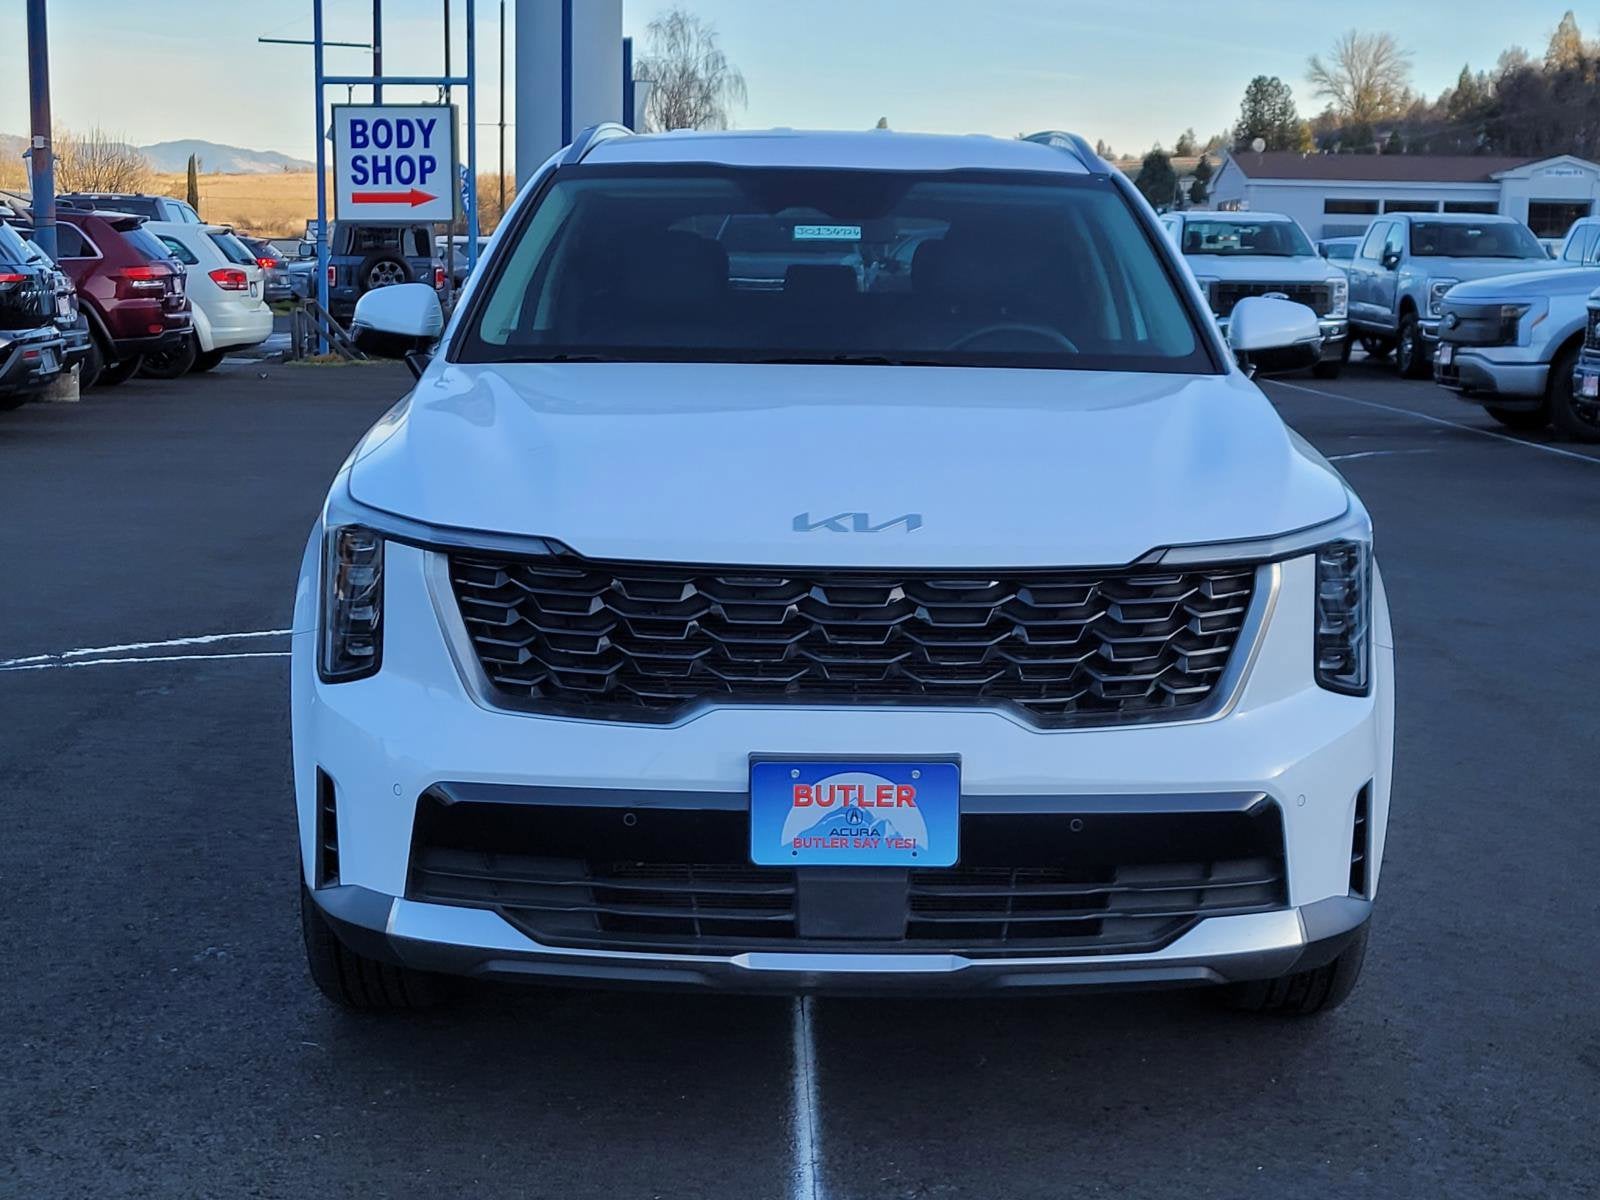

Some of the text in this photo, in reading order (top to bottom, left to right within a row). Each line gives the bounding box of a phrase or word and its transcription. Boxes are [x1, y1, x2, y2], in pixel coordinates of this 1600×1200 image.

[350, 118, 437, 149] BODY
[351, 154, 437, 185] SHOP
[792, 512, 922, 532] KIA
[793, 784, 916, 808] BUTLER
[829, 828, 881, 836] ACURA
[793, 838, 917, 849] BUTLER SAY YES!
